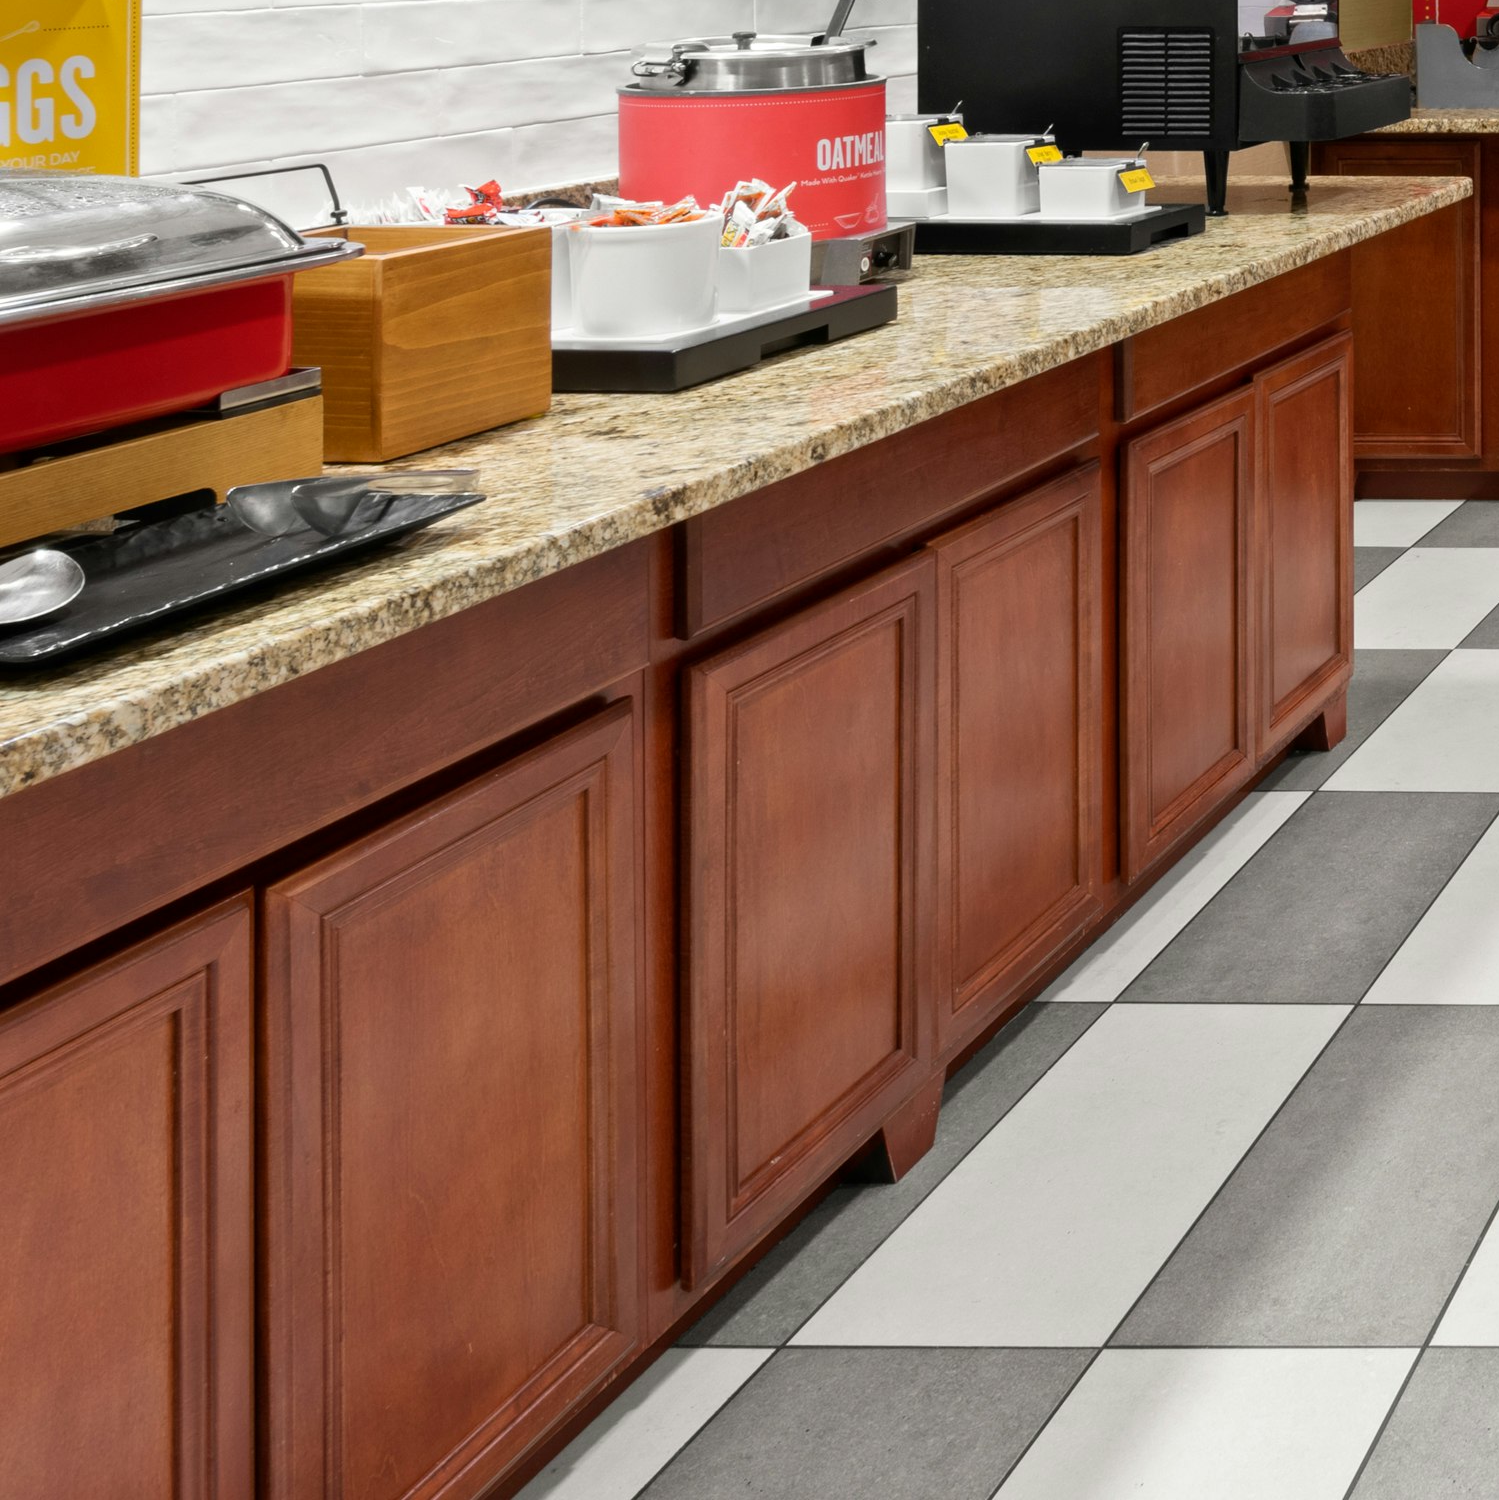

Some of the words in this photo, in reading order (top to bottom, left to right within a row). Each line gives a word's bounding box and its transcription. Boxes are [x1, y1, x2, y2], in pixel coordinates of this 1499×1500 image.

[0, 54, 97, 148] GS
[49, 150, 80, 166] DAY
[816, 130, 884, 171] OATMEAL
[800, 178, 820, 186] Made
[821, 176, 837, 184] With
